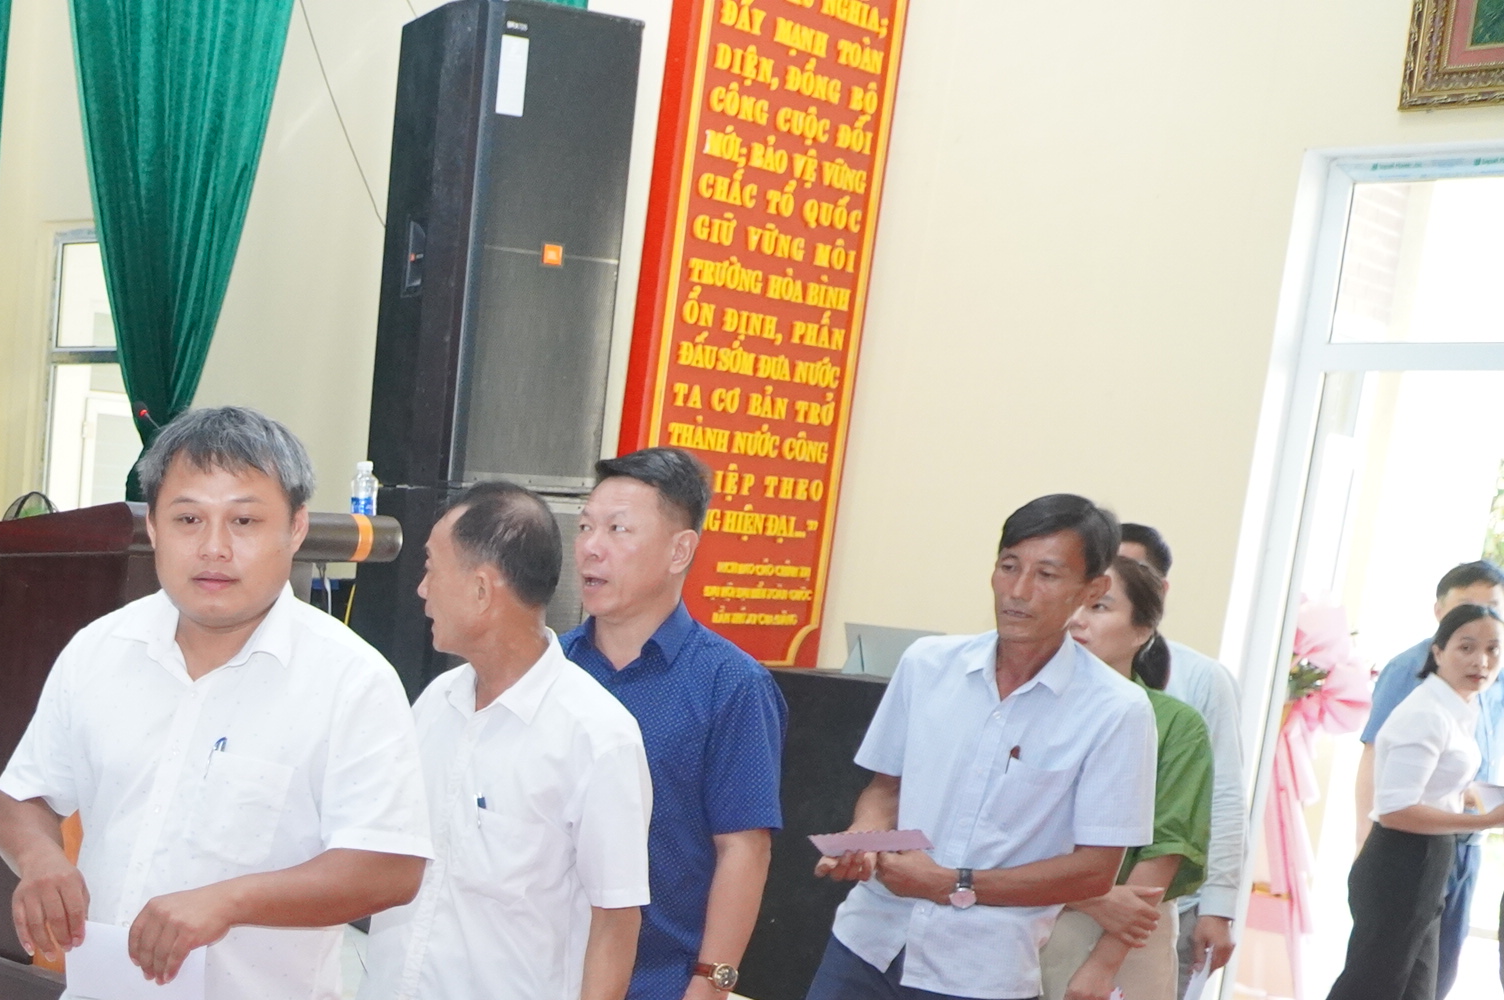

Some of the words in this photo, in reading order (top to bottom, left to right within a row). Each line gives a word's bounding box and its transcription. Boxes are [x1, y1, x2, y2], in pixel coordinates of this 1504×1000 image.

[714, 42, 779, 91] DIỆN,
[774, 16, 829, 58] MẠNH
[837, 36, 884, 75] TOÀN
[709, 81, 769, 126] CÔNG
[776, 106, 830, 146] CUỘC
[748, 134, 788, 174] BẢO
[792, 148, 818, 189] VỆ
[822, 158, 867, 194] VỮNG
[698, 168, 758, 208] CHẮC
[766, 179, 797, 217] TỔ
[803, 195, 862, 233] QUỐC
[693, 212, 737, 246] GIỮ
[747, 222, 805, 262] VỮNG
[813, 238, 856, 273] MÔI
[688, 256, 763, 295] TRƯỜNG
[805, 274, 851, 312] BÌNH
[682, 285, 716, 327] ỔN
[721, 307, 783, 346] ĐỊNH,
[791, 310, 846, 351] PHẤN
[677, 330, 718, 370] ĐẤU
[716, 340, 757, 376] SỚM
[756, 354, 791, 381] ĐƯA
[792, 356, 841, 389] NƯỚC
[673, 382, 702, 409] TA
[710, 387, 741, 414] CƠ
[746, 385, 789, 420] BẢN
[795, 392, 835, 426] TRỞ
[668, 415, 731, 453] THÀNH
[731, 423, 780, 458] NƯỚC
[782, 431, 829, 464] CÔNG
[764, 475, 824, 502] THEO
[722, 503, 765, 541] HIỆN
